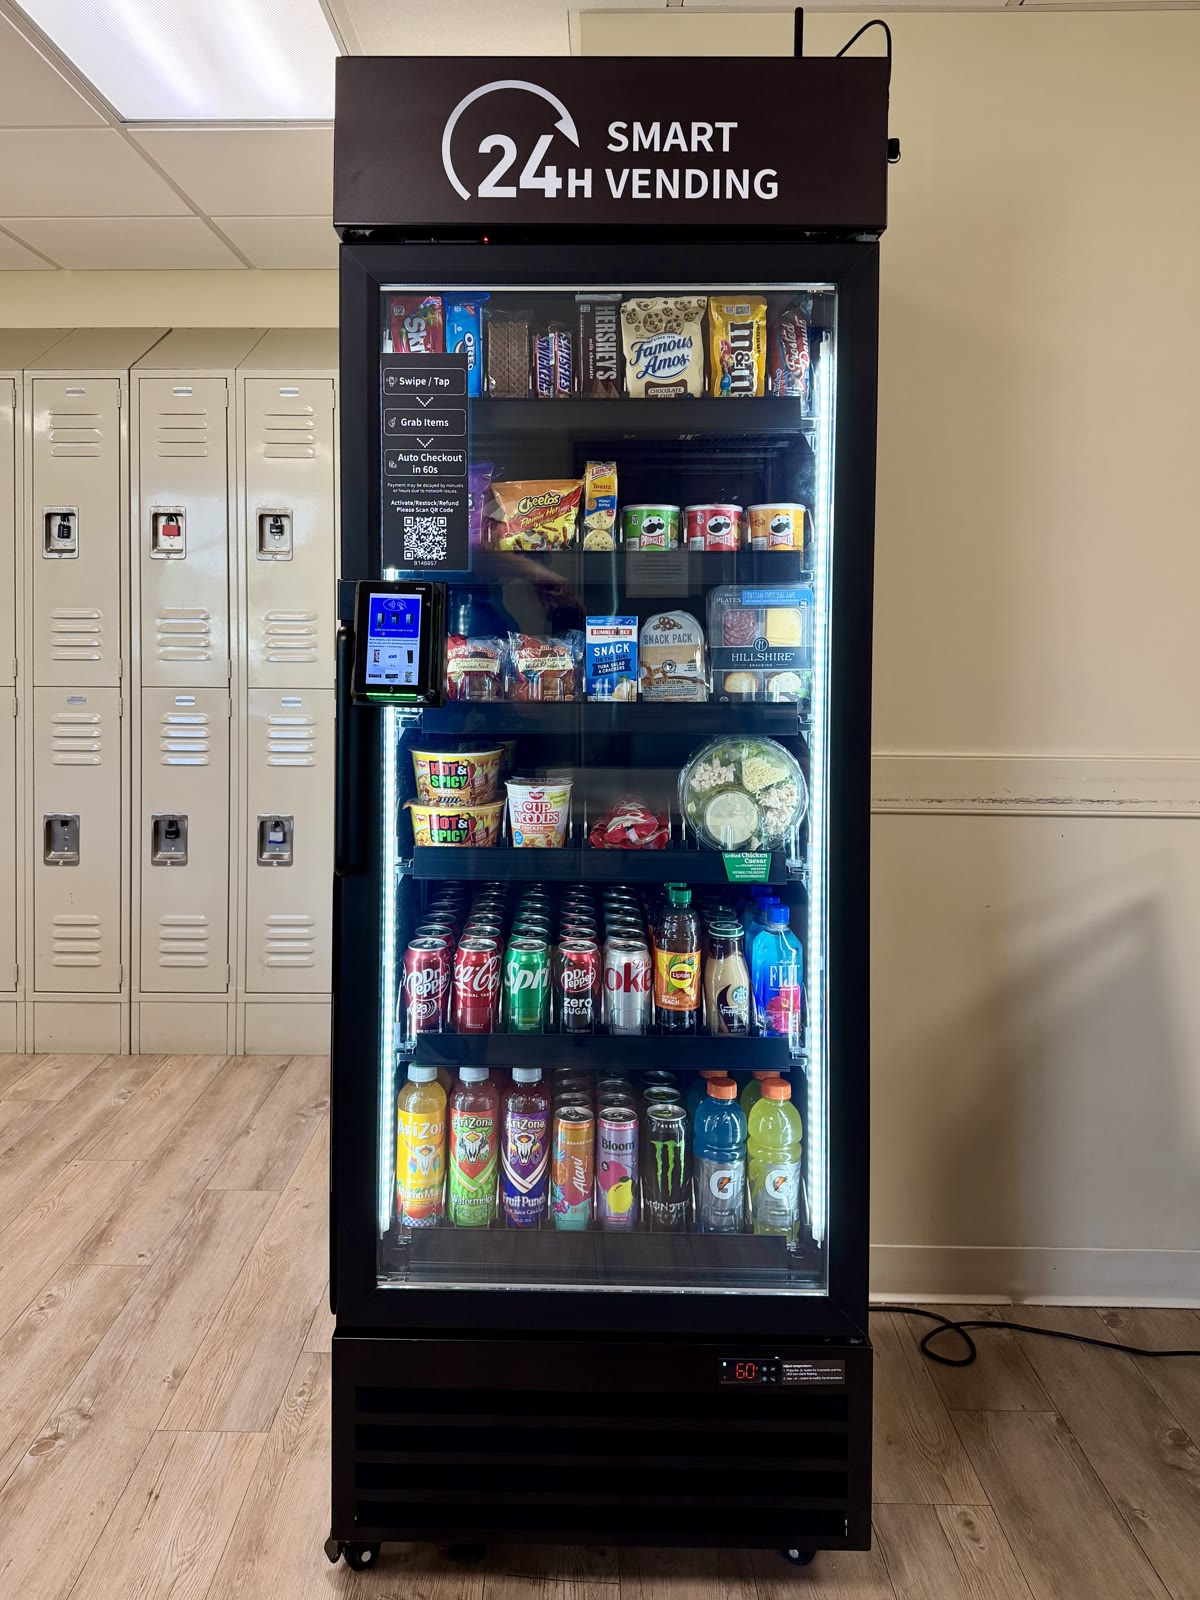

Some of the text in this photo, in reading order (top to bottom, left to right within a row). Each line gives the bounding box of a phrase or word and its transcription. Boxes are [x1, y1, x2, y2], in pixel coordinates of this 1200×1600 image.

[606, 120, 738, 153] SMART
[605, 168, 779, 200] VENDING
[595, 305, 617, 380] HERSHEY'S
[781, 323, 801, 370] Frosted
[794, 315, 810, 366] Donuts
[464, 332, 476, 371] OREO
[629, 335, 693, 366] Famous
[537, 336, 551, 394] SNICKERS
[557, 332, 572, 394] SATISFIES
[636, 353, 690, 379] Amos
[399, 376, 450, 388] Swipe / Tap
[400, 418, 449, 427] Grab Items
[398, 453, 462, 462] Auto Checkout
[412, 465, 438, 474] in 60s
[591, 467, 612, 477] Lance
[518, 493, 561, 514] Cheetos
[640, 534, 666, 547] PRINGLES
[706, 534, 734, 547] PRINGLES
[643, 633, 693, 645] SNACK PACK
[593, 643, 630, 657] SNACK
[731, 652, 792, 662] HILLSHIRE
[602, 666, 625, 674] CRACKERS
[430, 763, 457, 776] HOT
[431, 775, 467, 788] SPICY
[522, 801, 551, 814] CUP
[430, 816, 457, 830] HOT
[514, 811, 559, 824] NOODLES
[431, 829, 467, 843] SPICY
[422, 968, 441, 984] Dr
[563, 970, 594, 989] Pepper
[573, 969, 587, 980] Dr
[604, 962, 652, 993] oke
[769, 965, 798, 988] FIJI
[410, 970, 449, 998] Pepper
[416, 1003, 427, 1014] 23
[563, 997, 593, 1008] zero
[661, 998, 680, 1006] PEACH
[397, 1117, 444, 1139] AriZon
[453, 1114, 493, 1130] AriZona
[506, 1116, 545, 1130] AriZona
[601, 1136, 635, 1151] Bloom
[571, 1155, 589, 1197] Alani
[709, 1170, 734, 1200] G
[764, 1170, 791, 1200] G
[451, 1194, 495, 1206] Watermelon
[502, 1193, 520, 1207] Fruit
